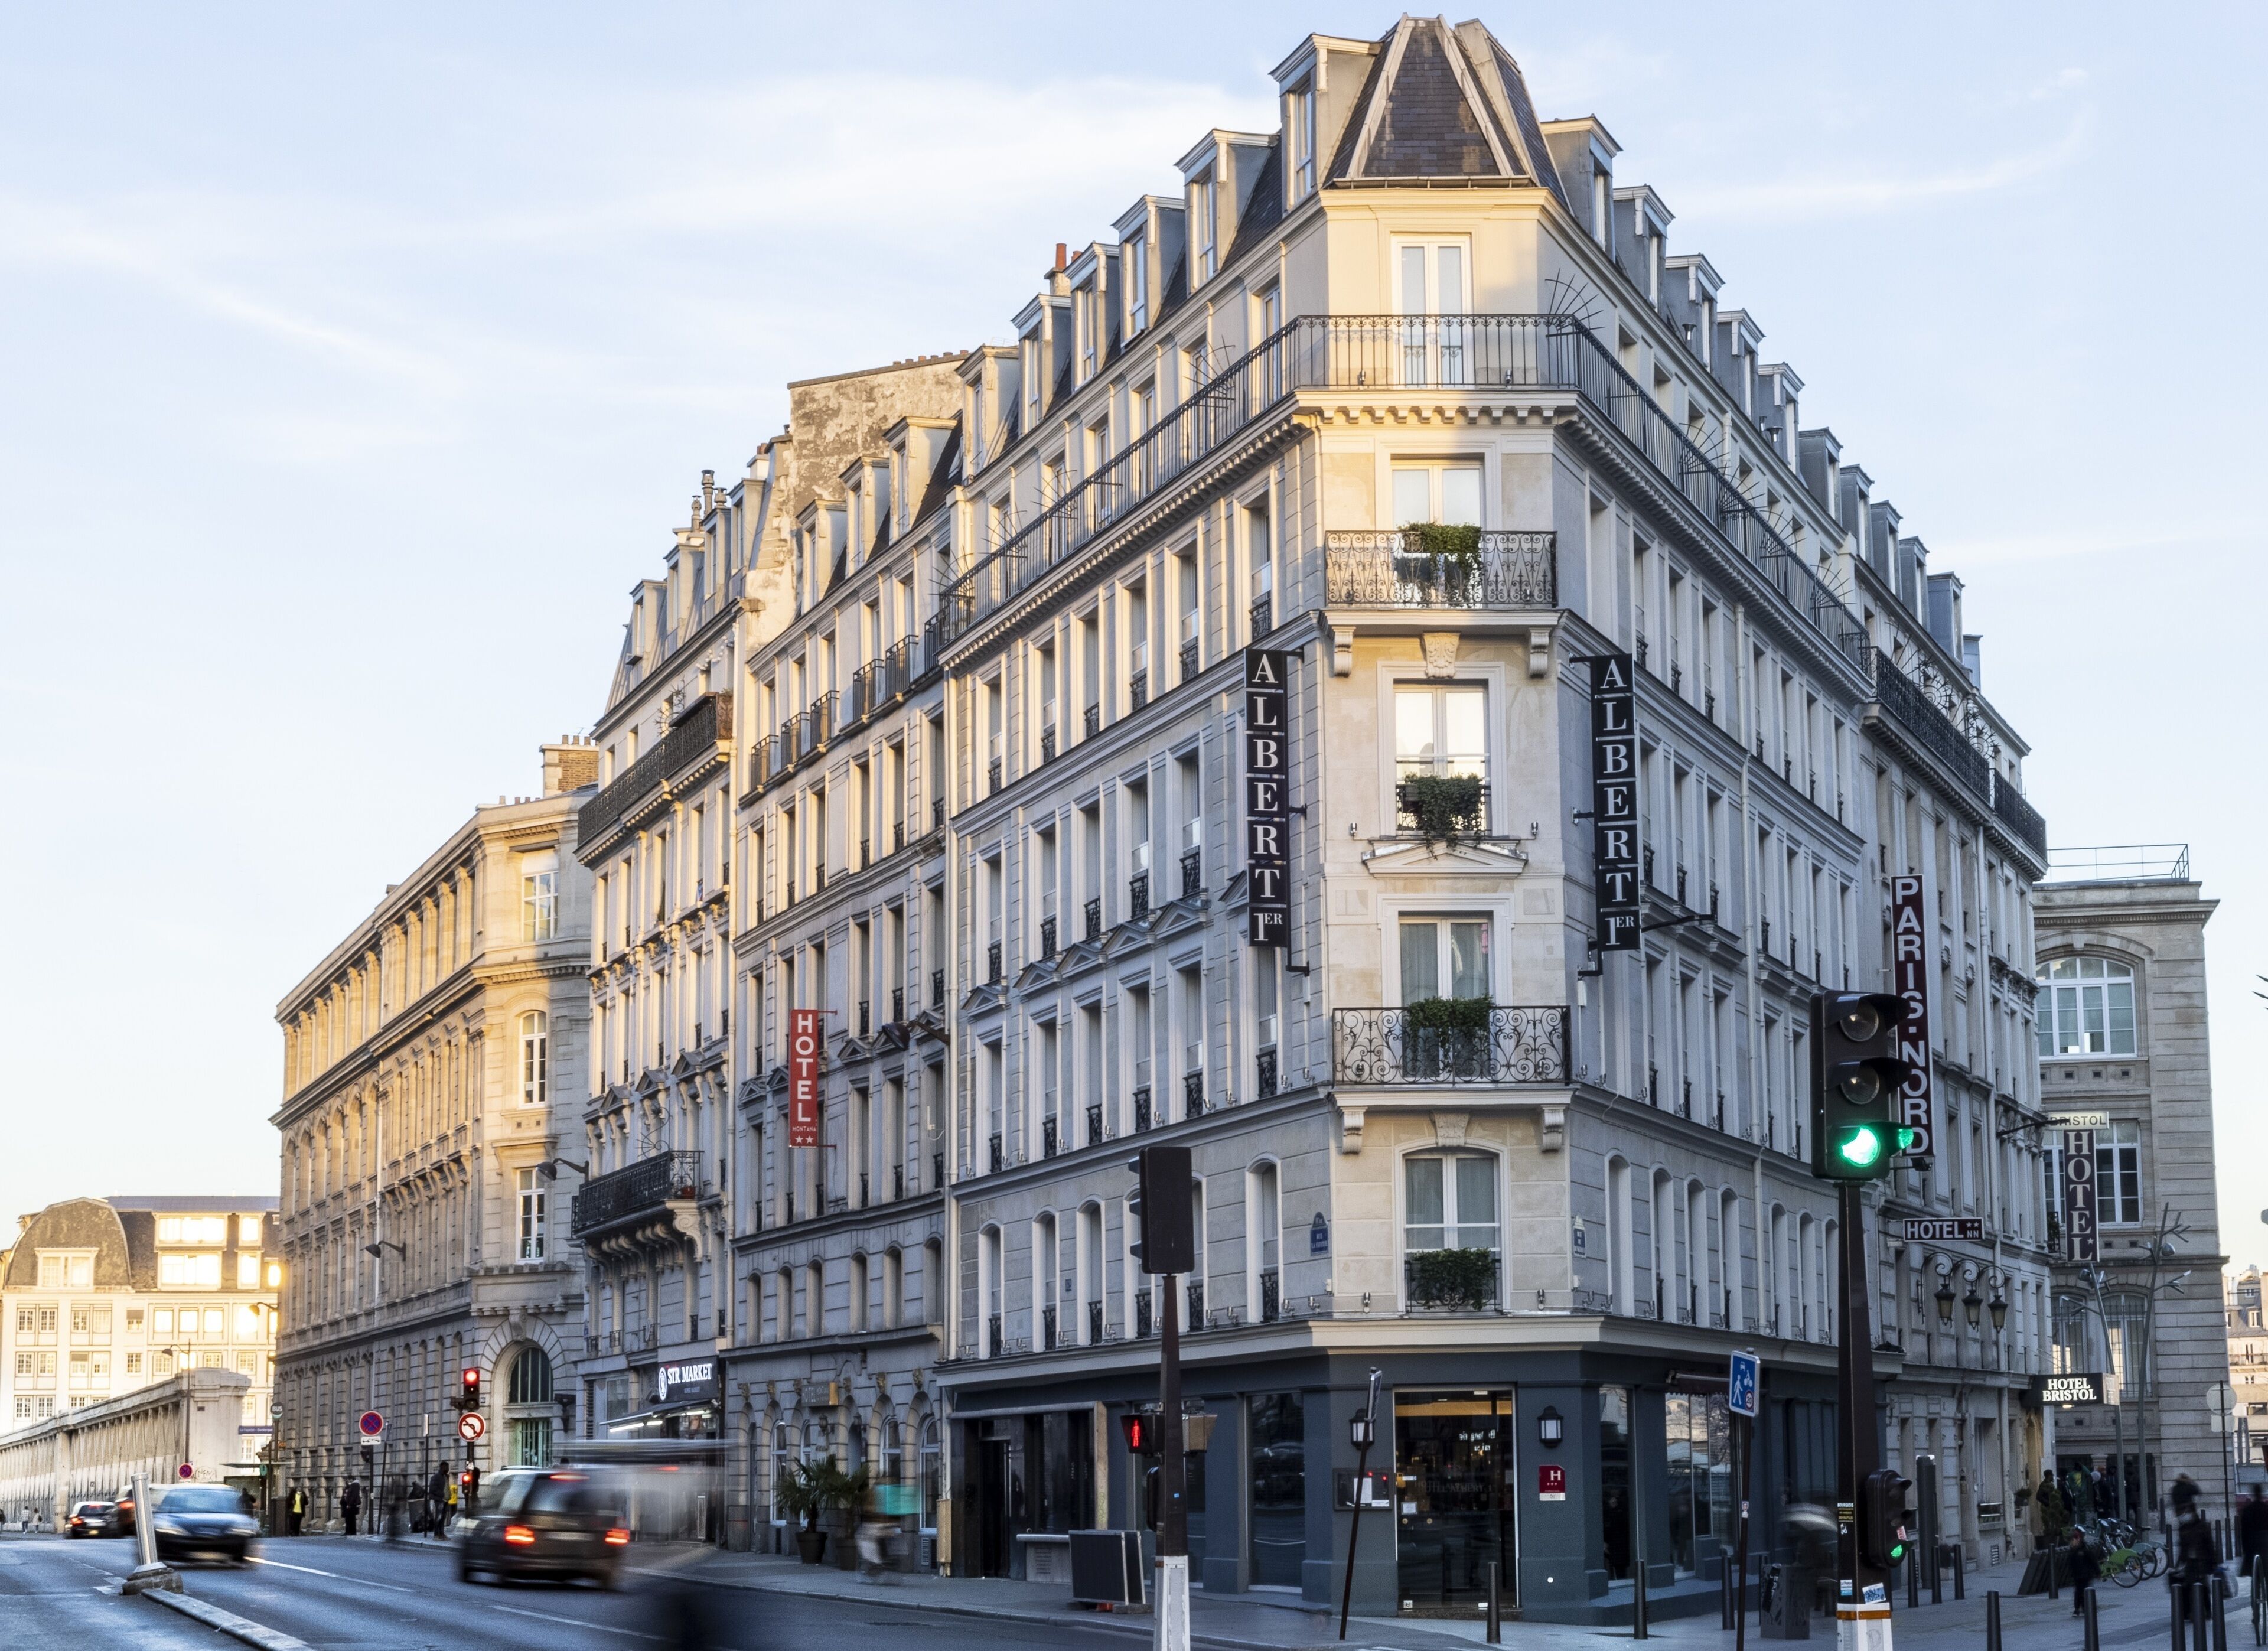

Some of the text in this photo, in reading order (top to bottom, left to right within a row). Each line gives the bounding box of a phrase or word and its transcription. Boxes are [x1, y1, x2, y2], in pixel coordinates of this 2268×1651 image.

[1252, 654, 1280, 898] ALBERT
[1600, 659, 1632, 902] ALBERT
[796, 1014, 814, 1122] HOTEL
[2066, 1131, 2093, 1261] HOTEL
[1907, 1221, 1964, 1239] HOTEL
[682, 1363, 712, 1382] MARKET
[2047, 1378, 2091, 1390] HOTEL
[2042, 1389, 2097, 1401] BRISTOL
[1550, 1470, 1561, 1481] H
